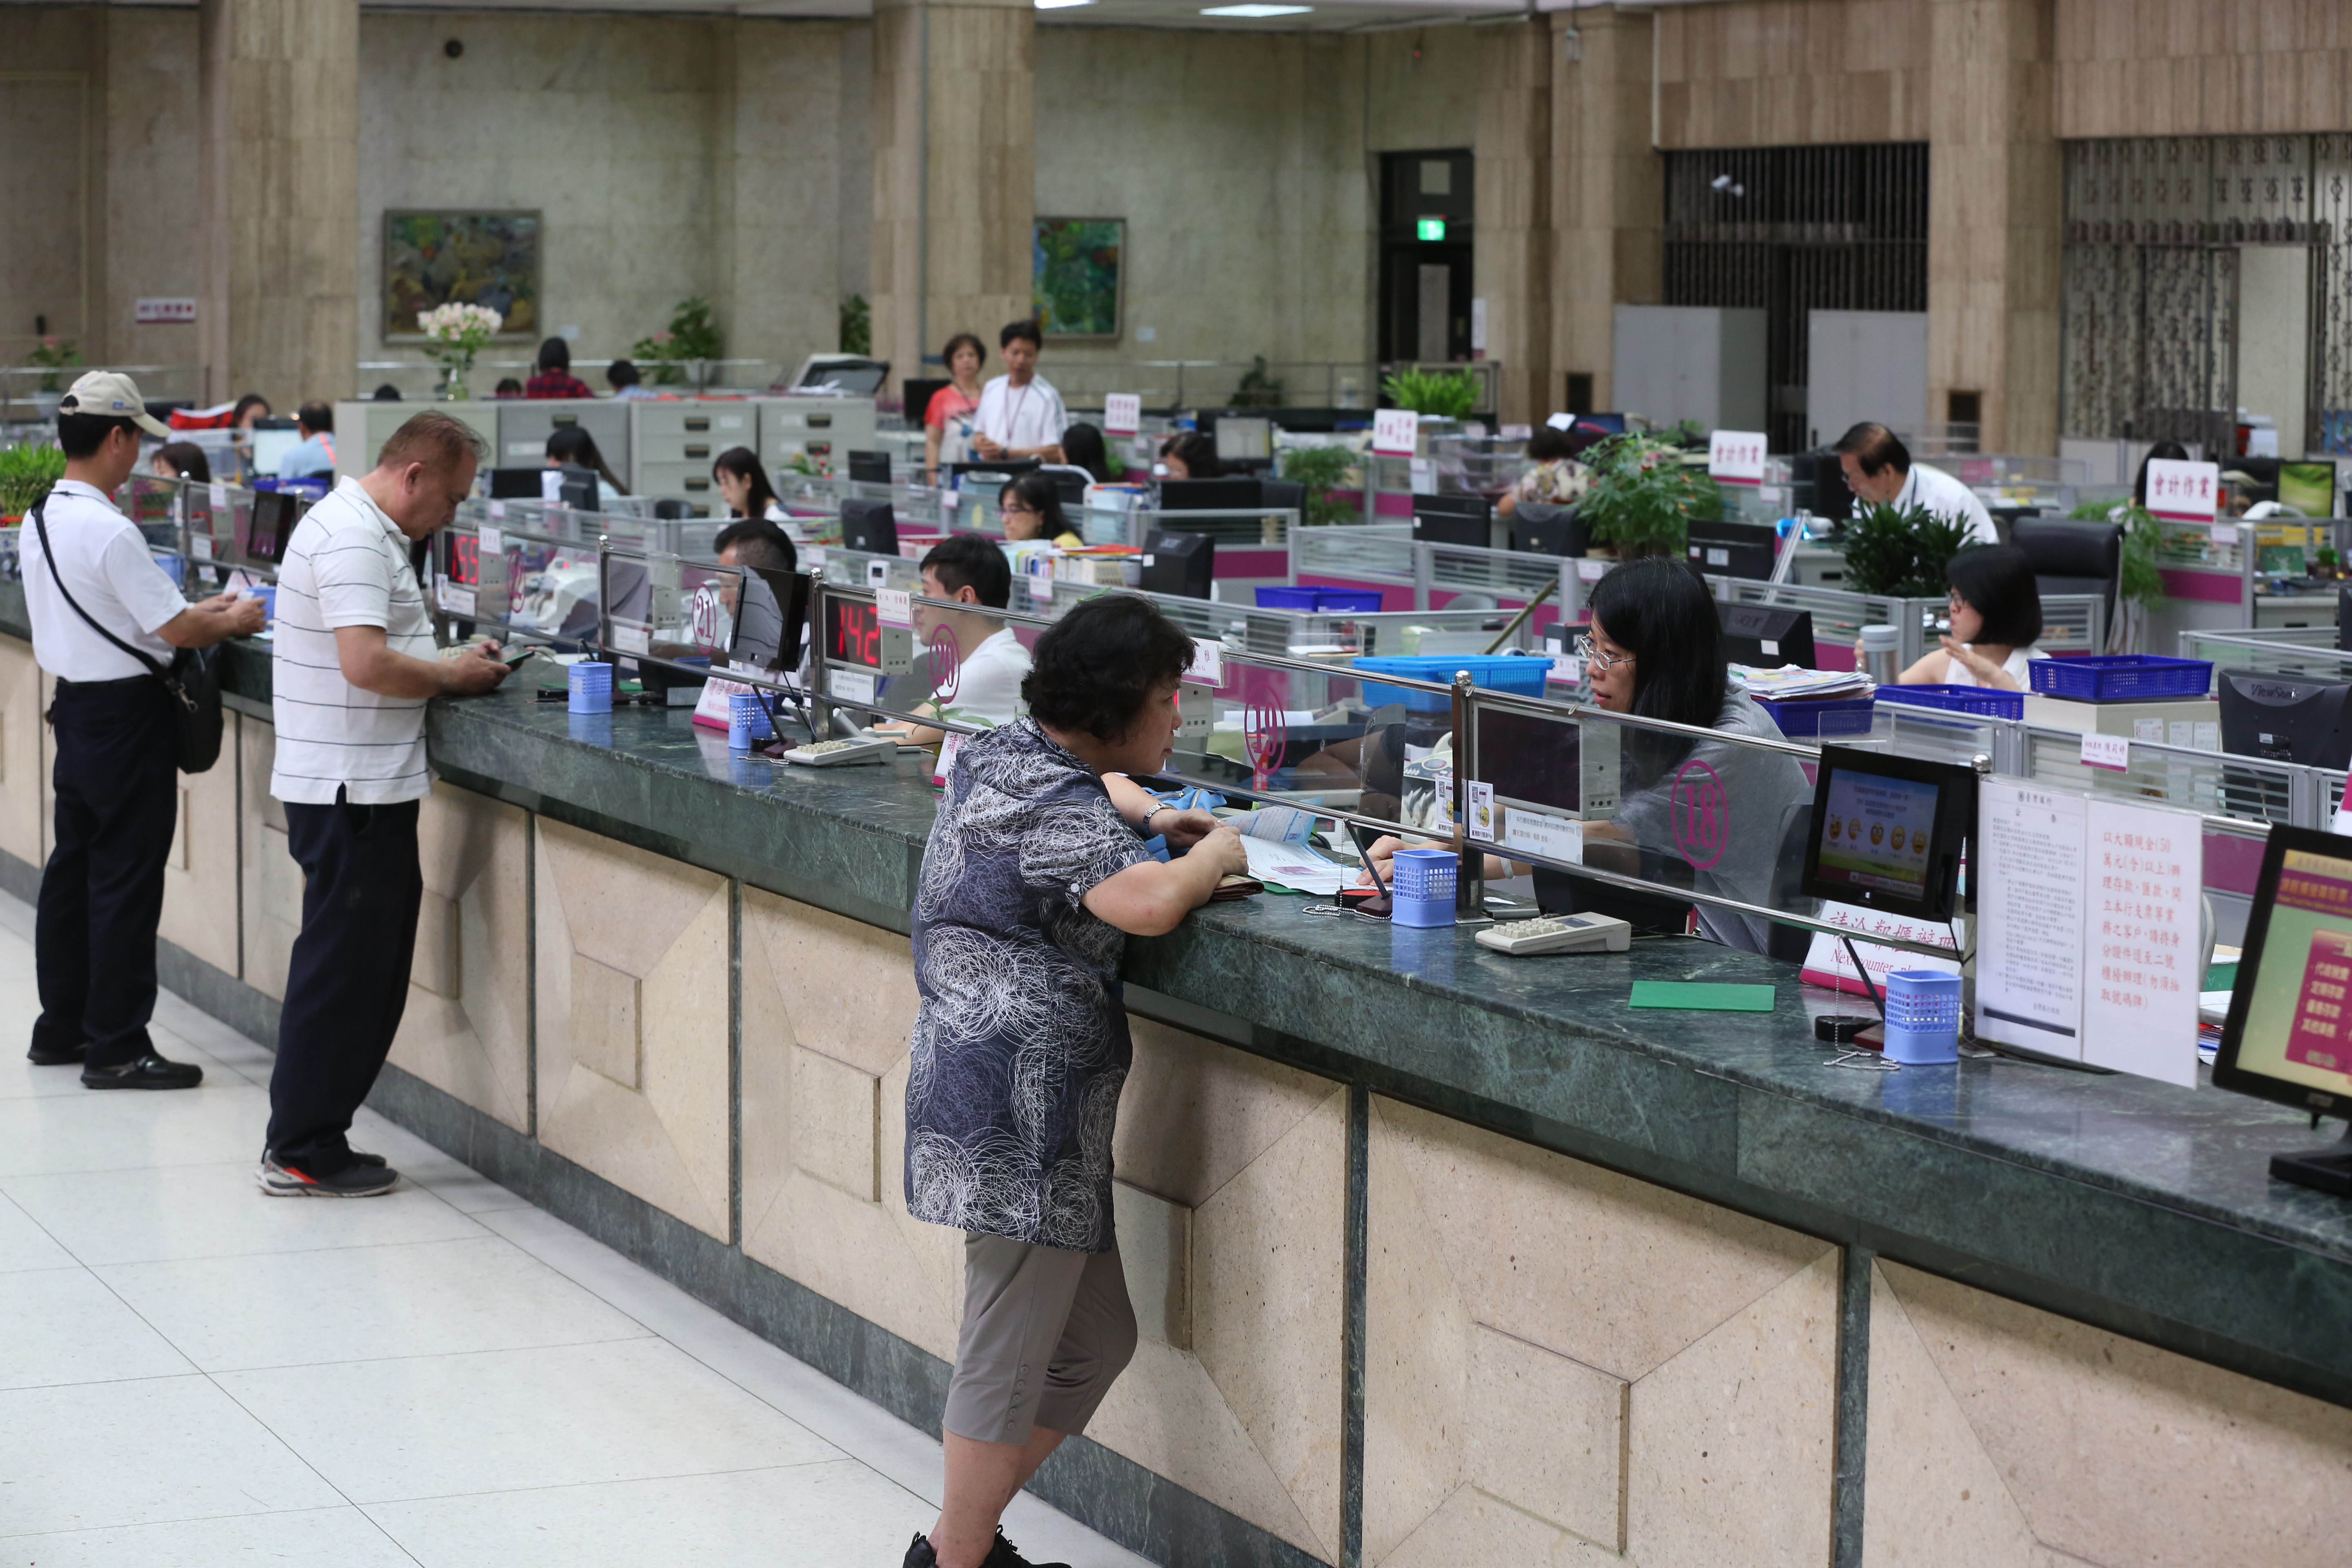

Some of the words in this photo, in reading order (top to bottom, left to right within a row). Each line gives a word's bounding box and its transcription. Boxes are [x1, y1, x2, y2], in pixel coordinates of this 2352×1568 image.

[2154, 472, 2211, 499] 會計作業
[452, 536, 479, 584] 155
[697, 595, 712, 639] 21
[839, 605, 881, 665] 142
[936, 638, 955, 688] 20
[2251, 684, 2301, 701] ViewSonic
[1253, 702, 1278, 757] 19
[1481, 812, 1490, 822] Pay
[1683, 782, 1717, 849] 18
